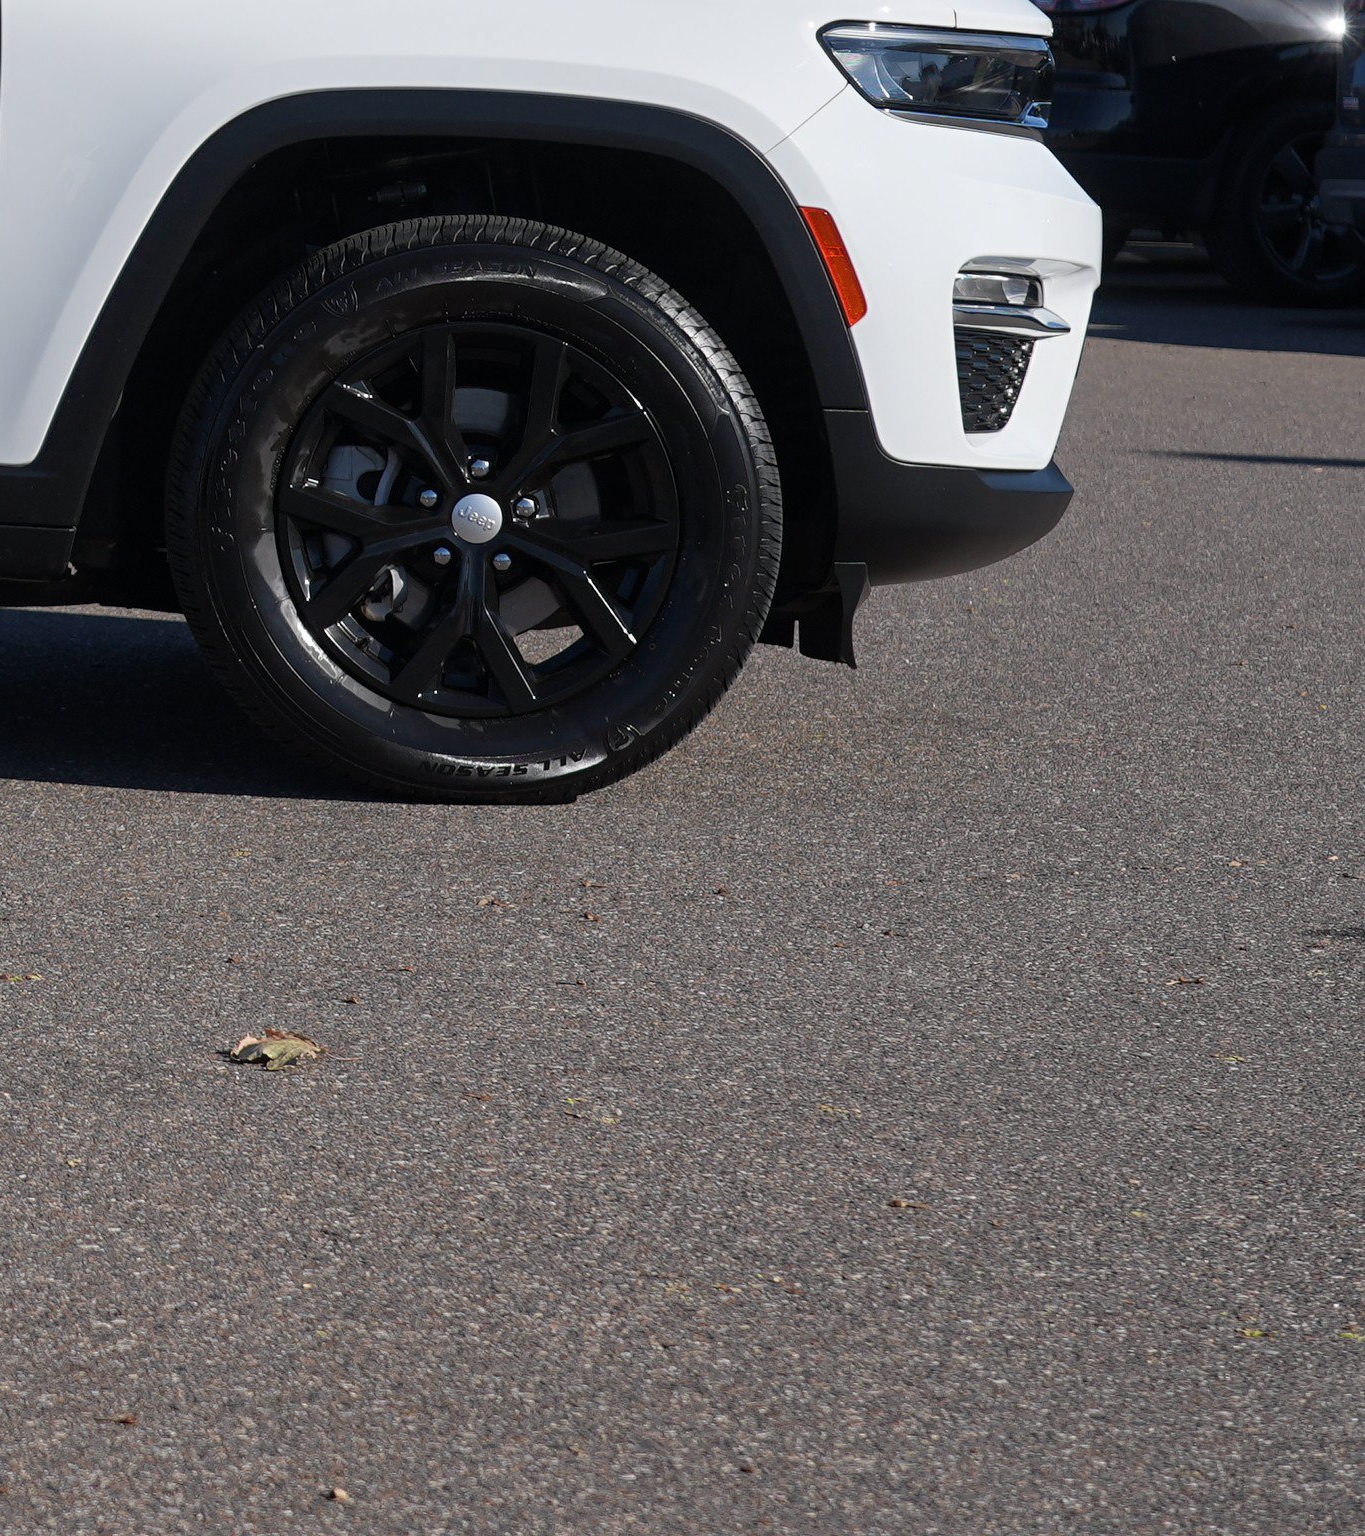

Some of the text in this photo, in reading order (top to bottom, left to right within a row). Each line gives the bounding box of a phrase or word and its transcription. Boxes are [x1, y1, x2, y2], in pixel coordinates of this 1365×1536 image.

[458, 505, 496, 532] Jeep
[419, 748, 588, 777] ALL SEASON
